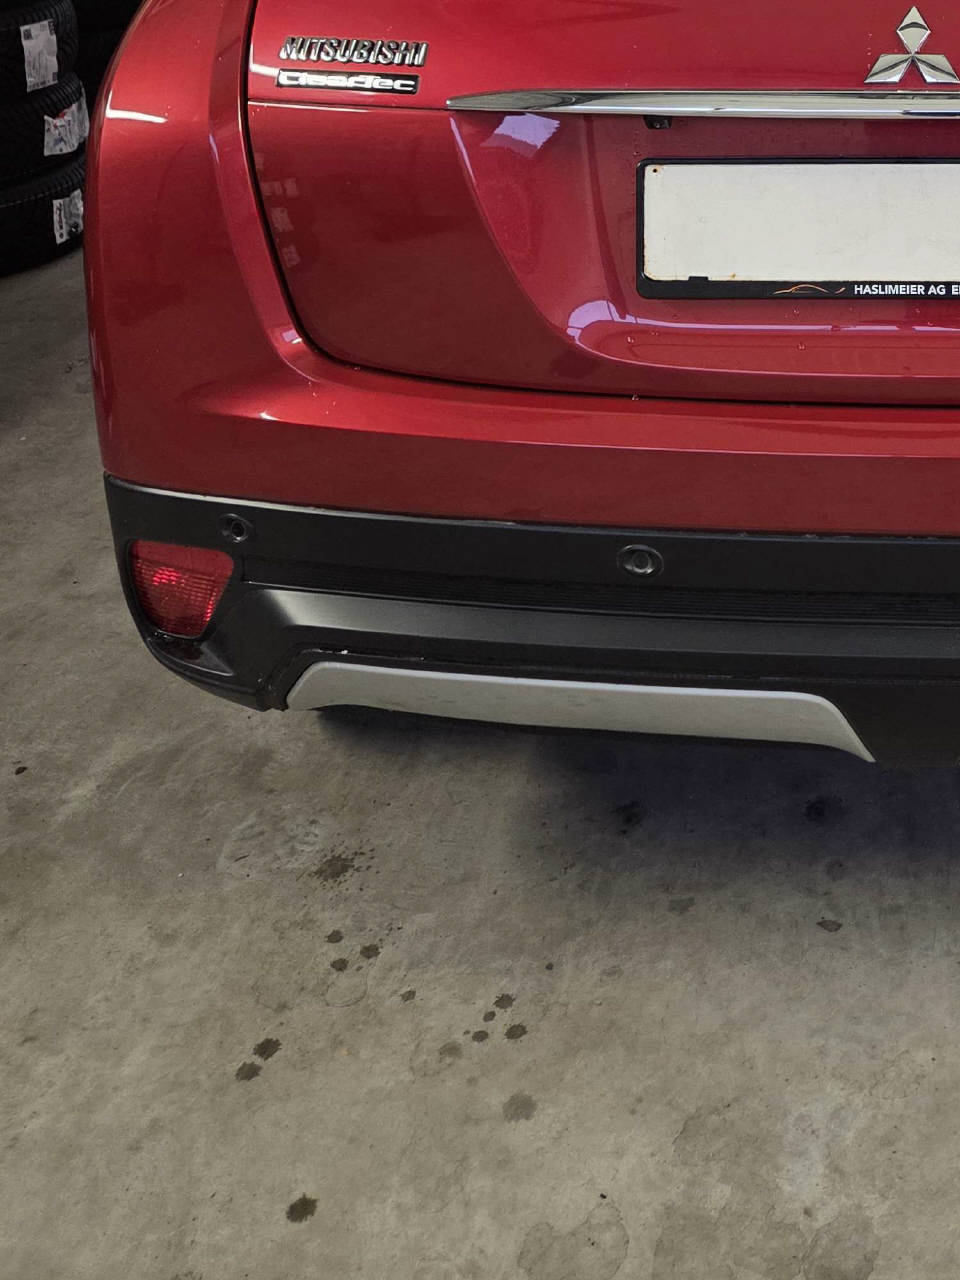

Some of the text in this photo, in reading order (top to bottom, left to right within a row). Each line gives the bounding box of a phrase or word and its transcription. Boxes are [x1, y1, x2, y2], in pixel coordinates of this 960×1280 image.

[278, 36, 429, 67] MITSUBISHI
[854, 284, 926, 296] HASLIMEIER
[928, 284, 946, 296] AG
